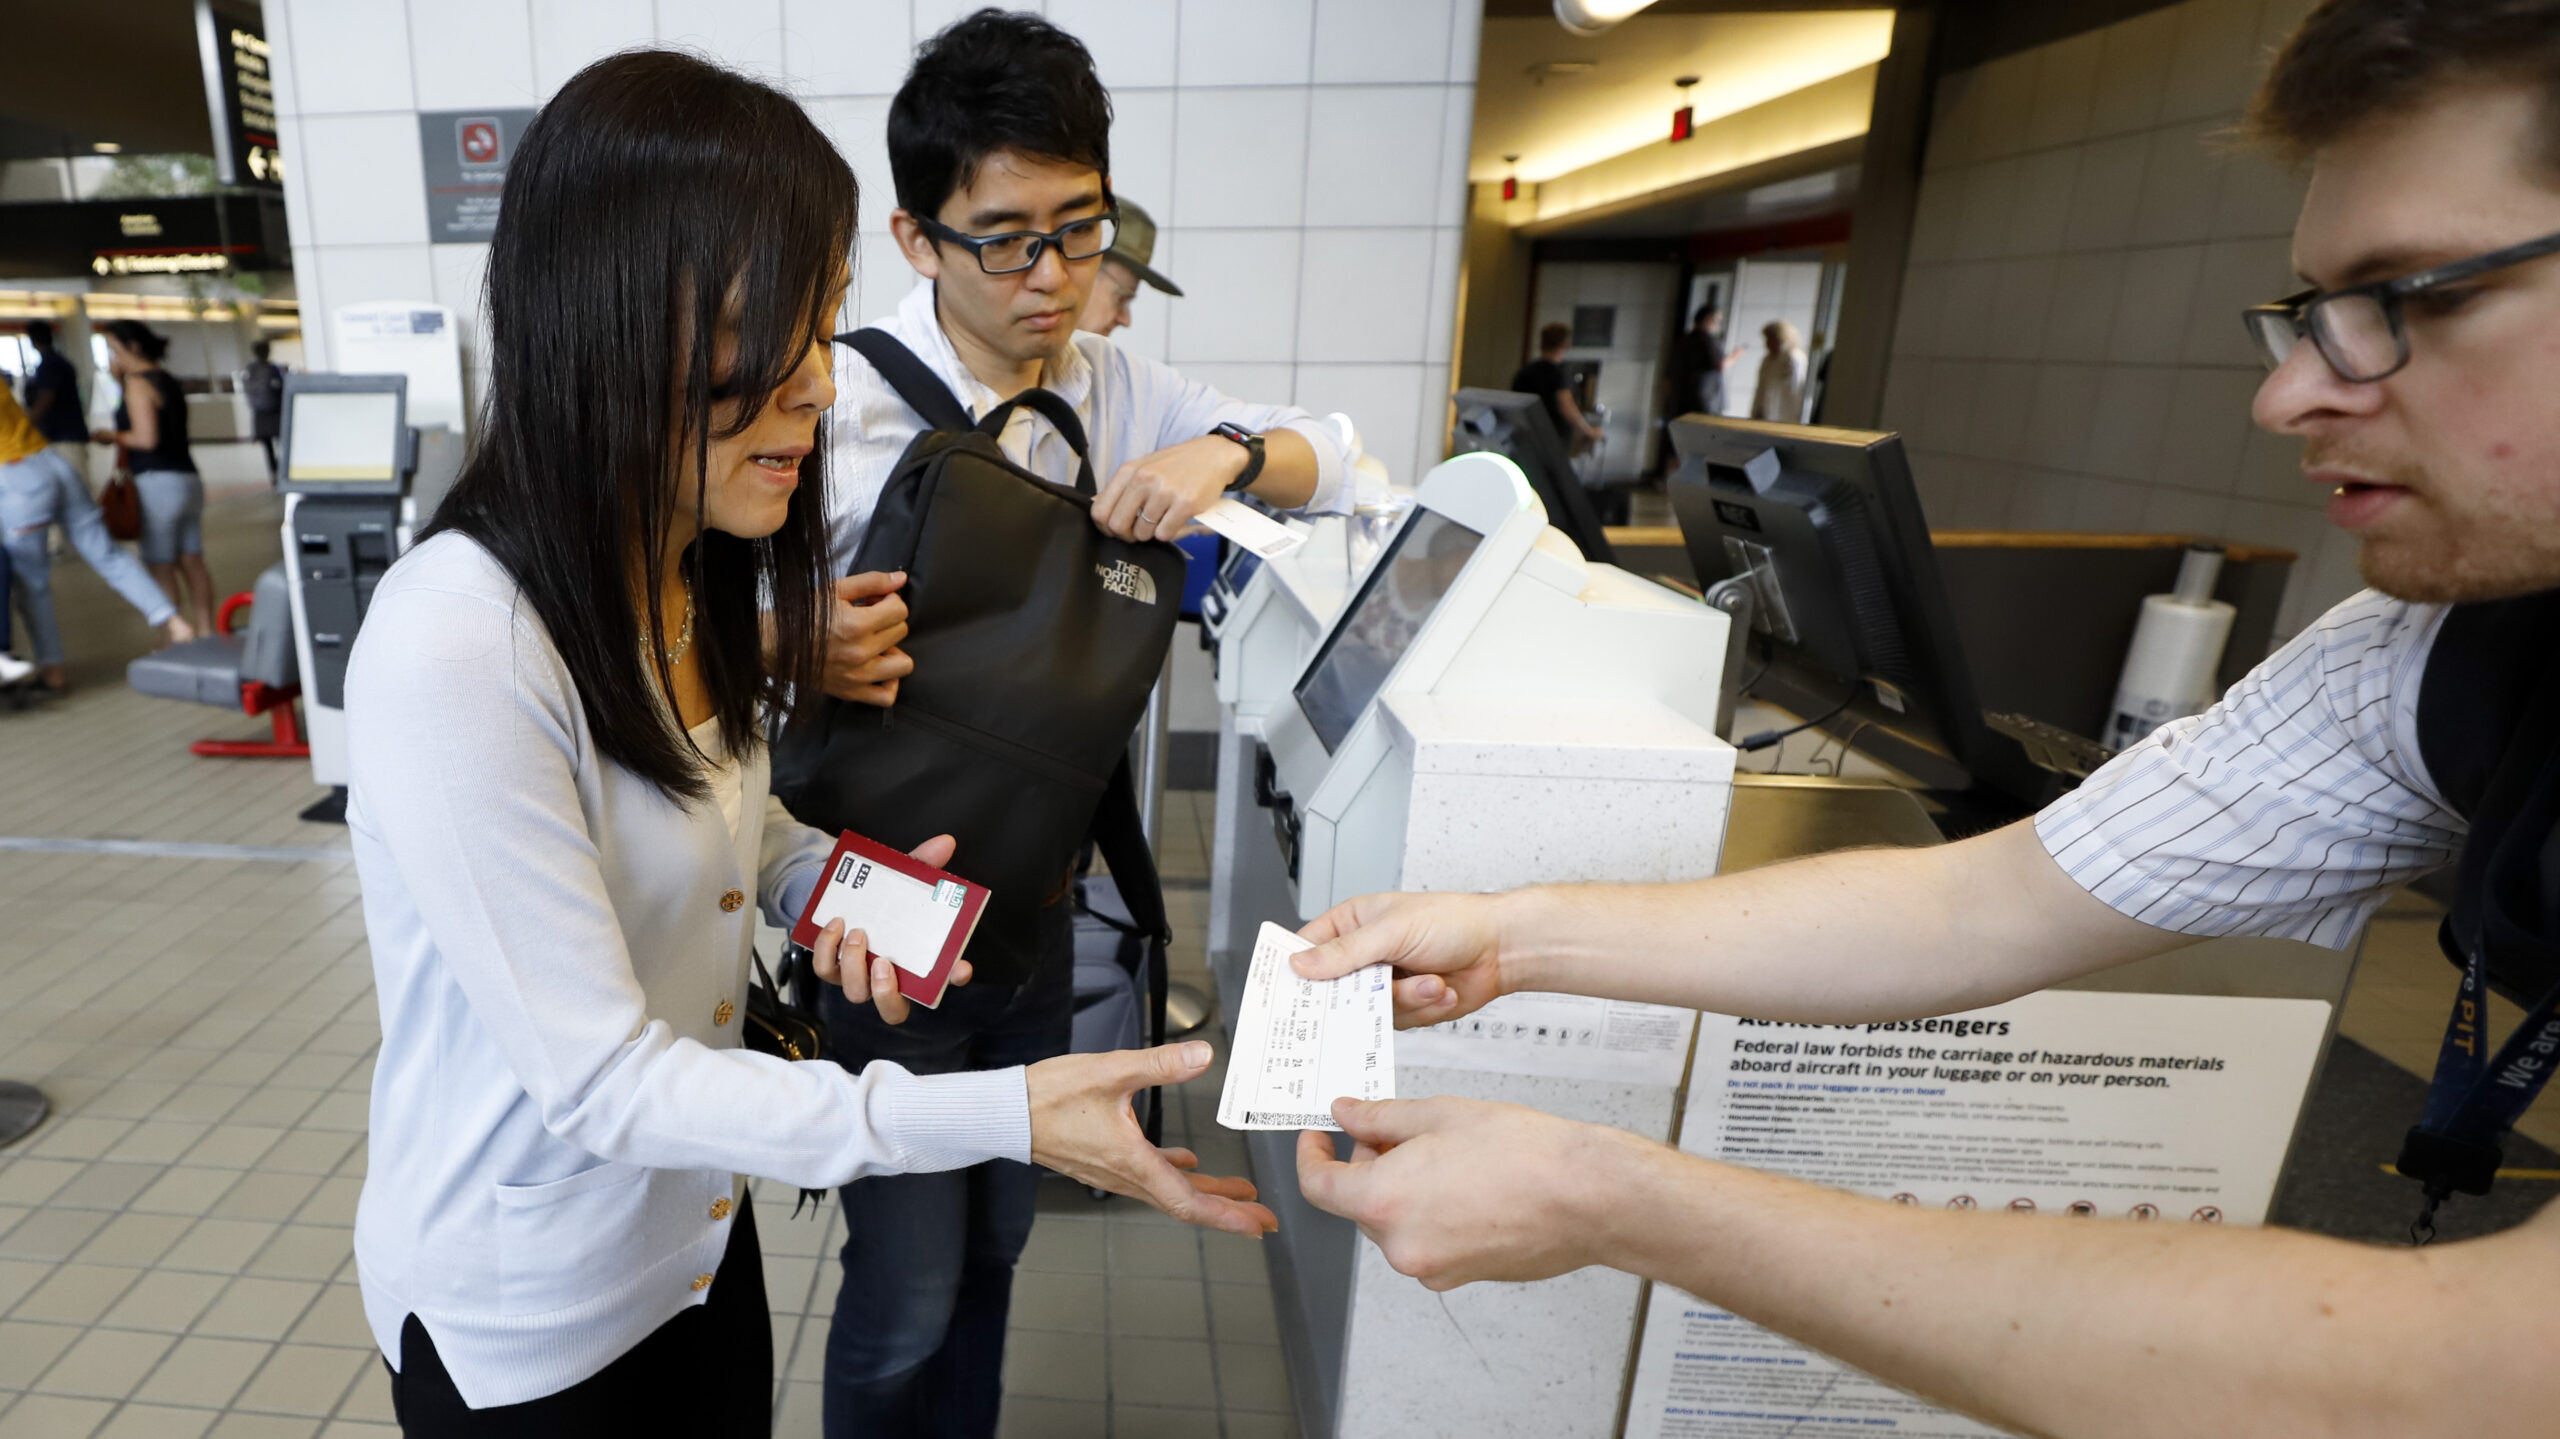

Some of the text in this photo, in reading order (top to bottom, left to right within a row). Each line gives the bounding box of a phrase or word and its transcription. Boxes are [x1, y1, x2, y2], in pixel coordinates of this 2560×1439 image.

[1095, 562, 1137, 588] NORTH
[1115, 559, 1139, 577] THE
[1103, 578, 1136, 598] FACE
[949, 886, 964, 907] ICTS
[1866, 1019, 2010, 1037] passengers
[2454, 1000, 2476, 1056] PIT
[1365, 1051, 1377, 1071] INTL
[1733, 1039, 2225, 1072] Federal law forbids the carriage of hazardous materials
[1730, 1058, 2171, 1089] aboard aircraft in your luggage or on your person.
[2497, 1056, 2544, 1088] We
[1743, 1081, 1759, 1089] not
[1761, 1081, 1783, 1091] pack
[1797, 1083, 1819, 1092] your
[1822, 1083, 1859, 1093] luggage
[1874, 1086, 1899, 1095] carry
[1902, 1087, 1915, 1095] on
[1917, 1087, 1946, 1096] board
[1675, 1352, 1807, 1366] Explanation of contract terms
